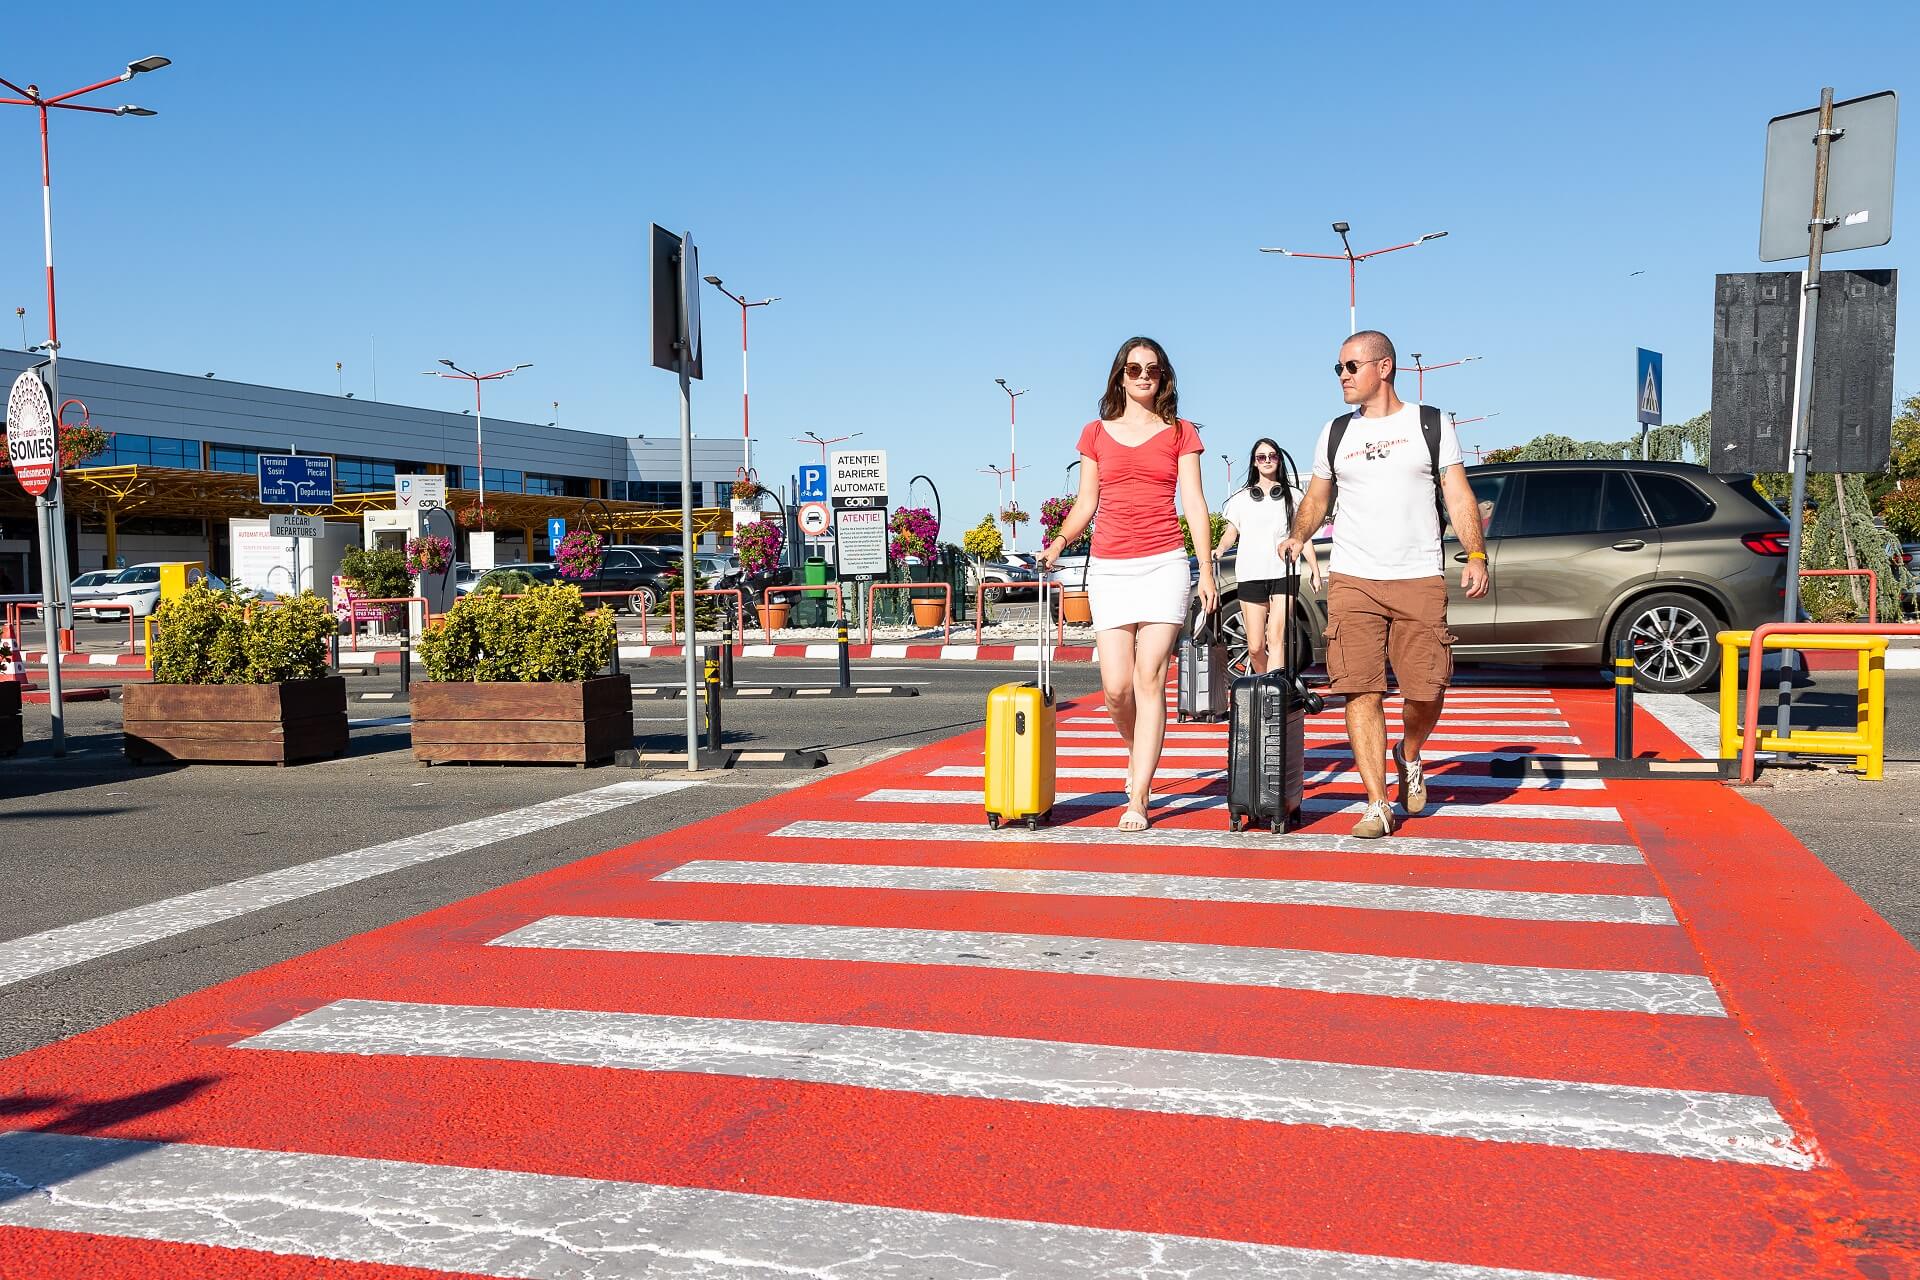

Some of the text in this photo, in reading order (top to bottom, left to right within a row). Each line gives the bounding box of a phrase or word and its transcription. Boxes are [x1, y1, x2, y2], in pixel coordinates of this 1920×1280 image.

[263, 457, 288, 466] Terminal
[305, 459, 329, 468] Terminal
[838, 455, 880, 467] ATENȚIE!
[267, 466, 285, 475] Sosiri
[838, 469, 880, 479] BARIERE
[806, 469, 820, 491] P
[263, 486, 286, 495] Arrivals
[401, 480, 410, 492] P
[833, 482, 886, 493] AUTOMATE
[300, 487, 331, 497] Departures
[842, 513, 880, 524] ATENȚIE!
[276, 526, 317, 537] DEPARTURES
